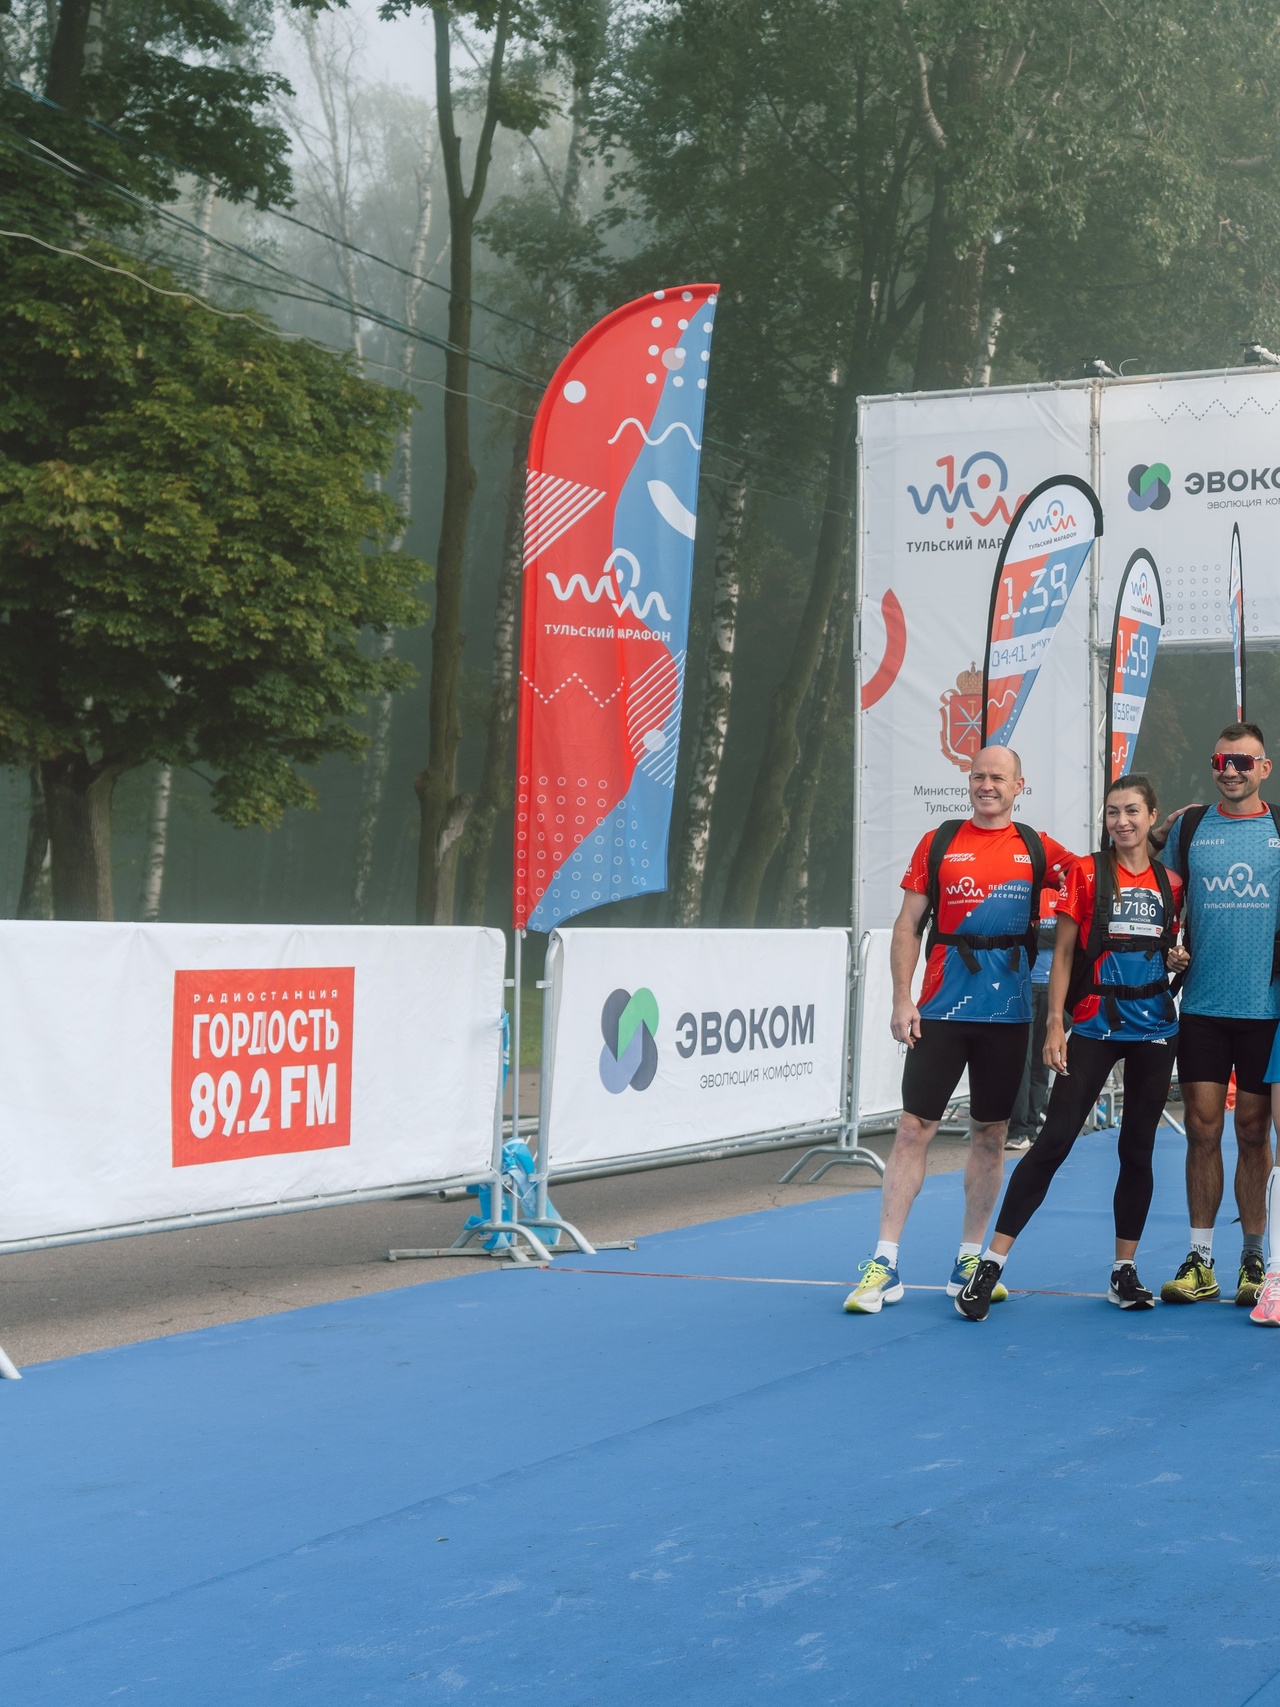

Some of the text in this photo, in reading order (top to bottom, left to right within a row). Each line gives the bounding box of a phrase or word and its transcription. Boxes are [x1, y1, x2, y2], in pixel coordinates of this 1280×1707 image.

[1207, 497, 1263, 511] эволюция
[907, 538, 973, 553] ТУЛЬСКИЙ
[1028, 531, 1078, 550] ТУЛЬСКИЙ МАРАФОН
[544, 623, 615, 639] ТУЛЬСКИЙ
[991, 645, 1027, 667] 04:41
[913, 785, 970, 798] Министер
[924, 801, 973, 815] Тульской
[1190, 838, 1225, 847] CEMAKER
[988, 884, 1030, 892] ПЕЙСМЕЙКЕР
[1124, 901, 1157, 917] 7186
[193, 989, 339, 1003] РАДИОСТАНЦИЯ
[192, 1008, 339, 1059] ГОРДОСТЬ
[675, 1004, 815, 1059] ЭВОКОМ
[699, 1060, 814, 1091] эволюция комфорта
[189, 1061, 337, 1139] 89.2 FM
